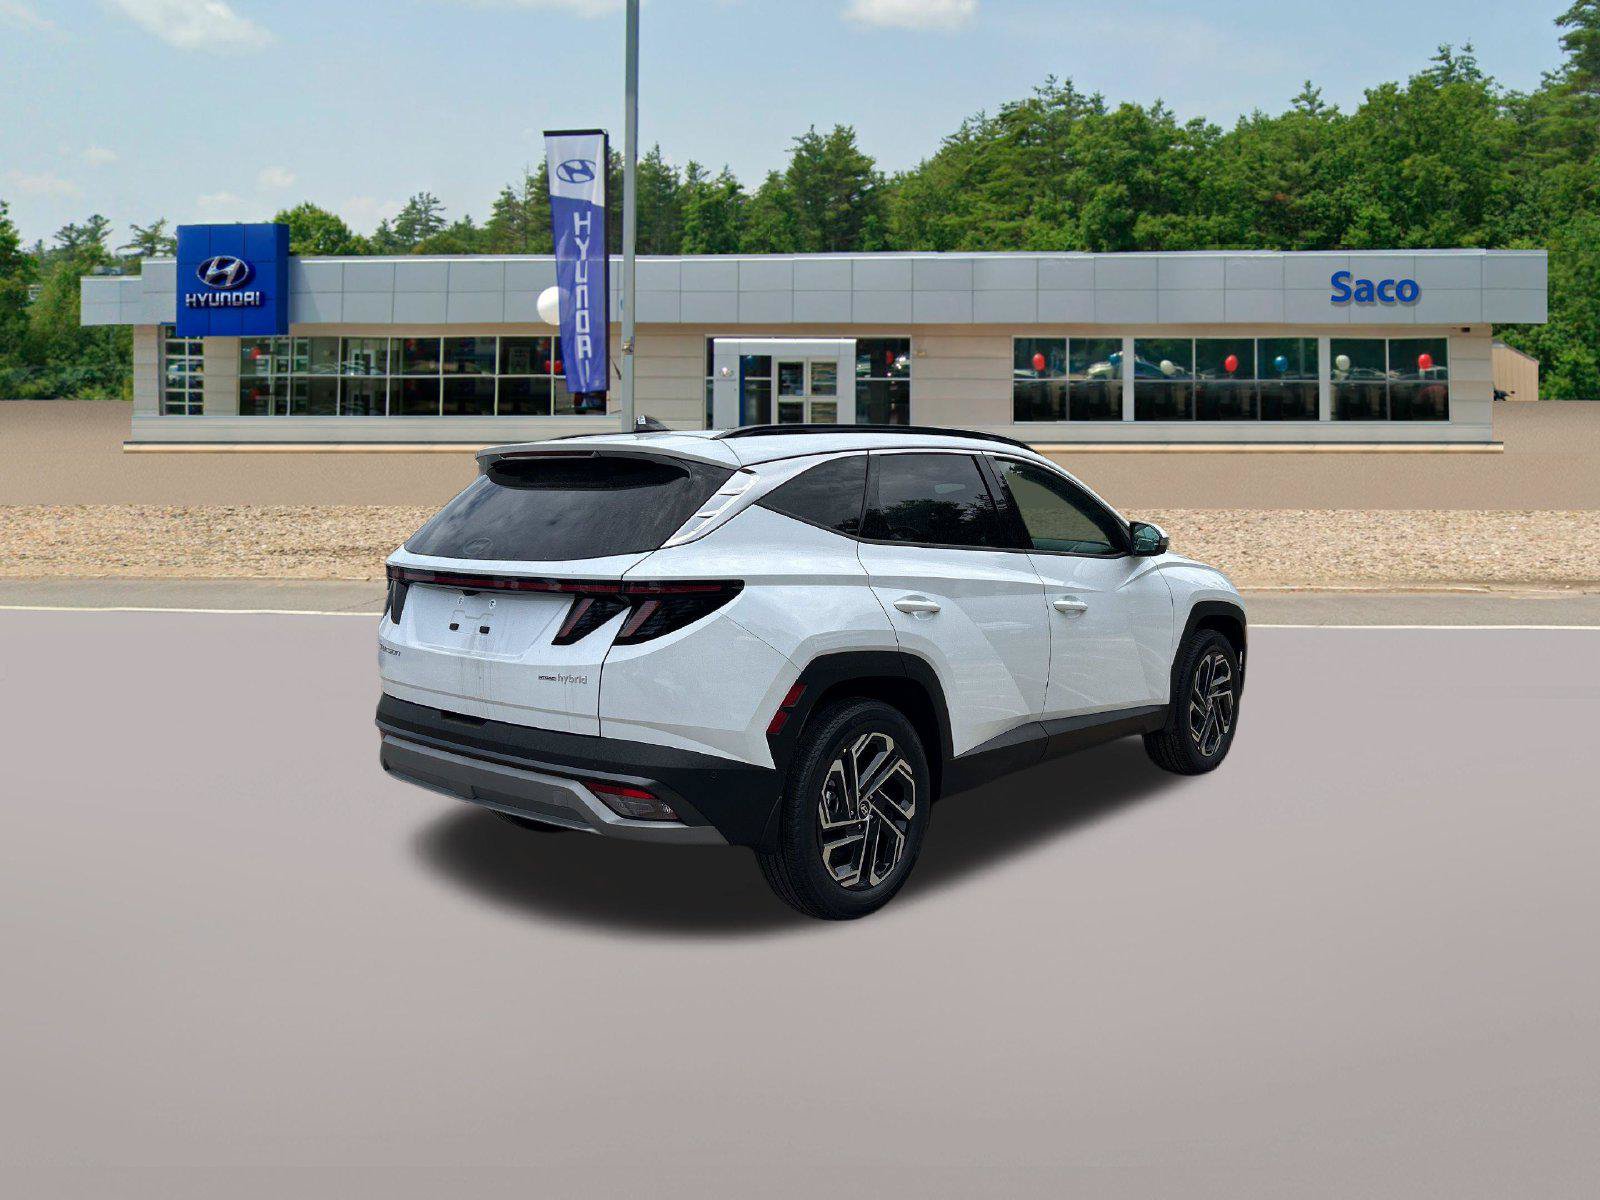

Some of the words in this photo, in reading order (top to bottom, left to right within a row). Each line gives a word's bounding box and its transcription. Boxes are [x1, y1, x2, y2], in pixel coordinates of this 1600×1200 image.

[573, 211, 592, 384] HYUNDAI
[1330, 270, 1420, 303] Saco
[185, 291, 261, 307] HYUNDAI
[557, 673, 588, 685] hybrid
